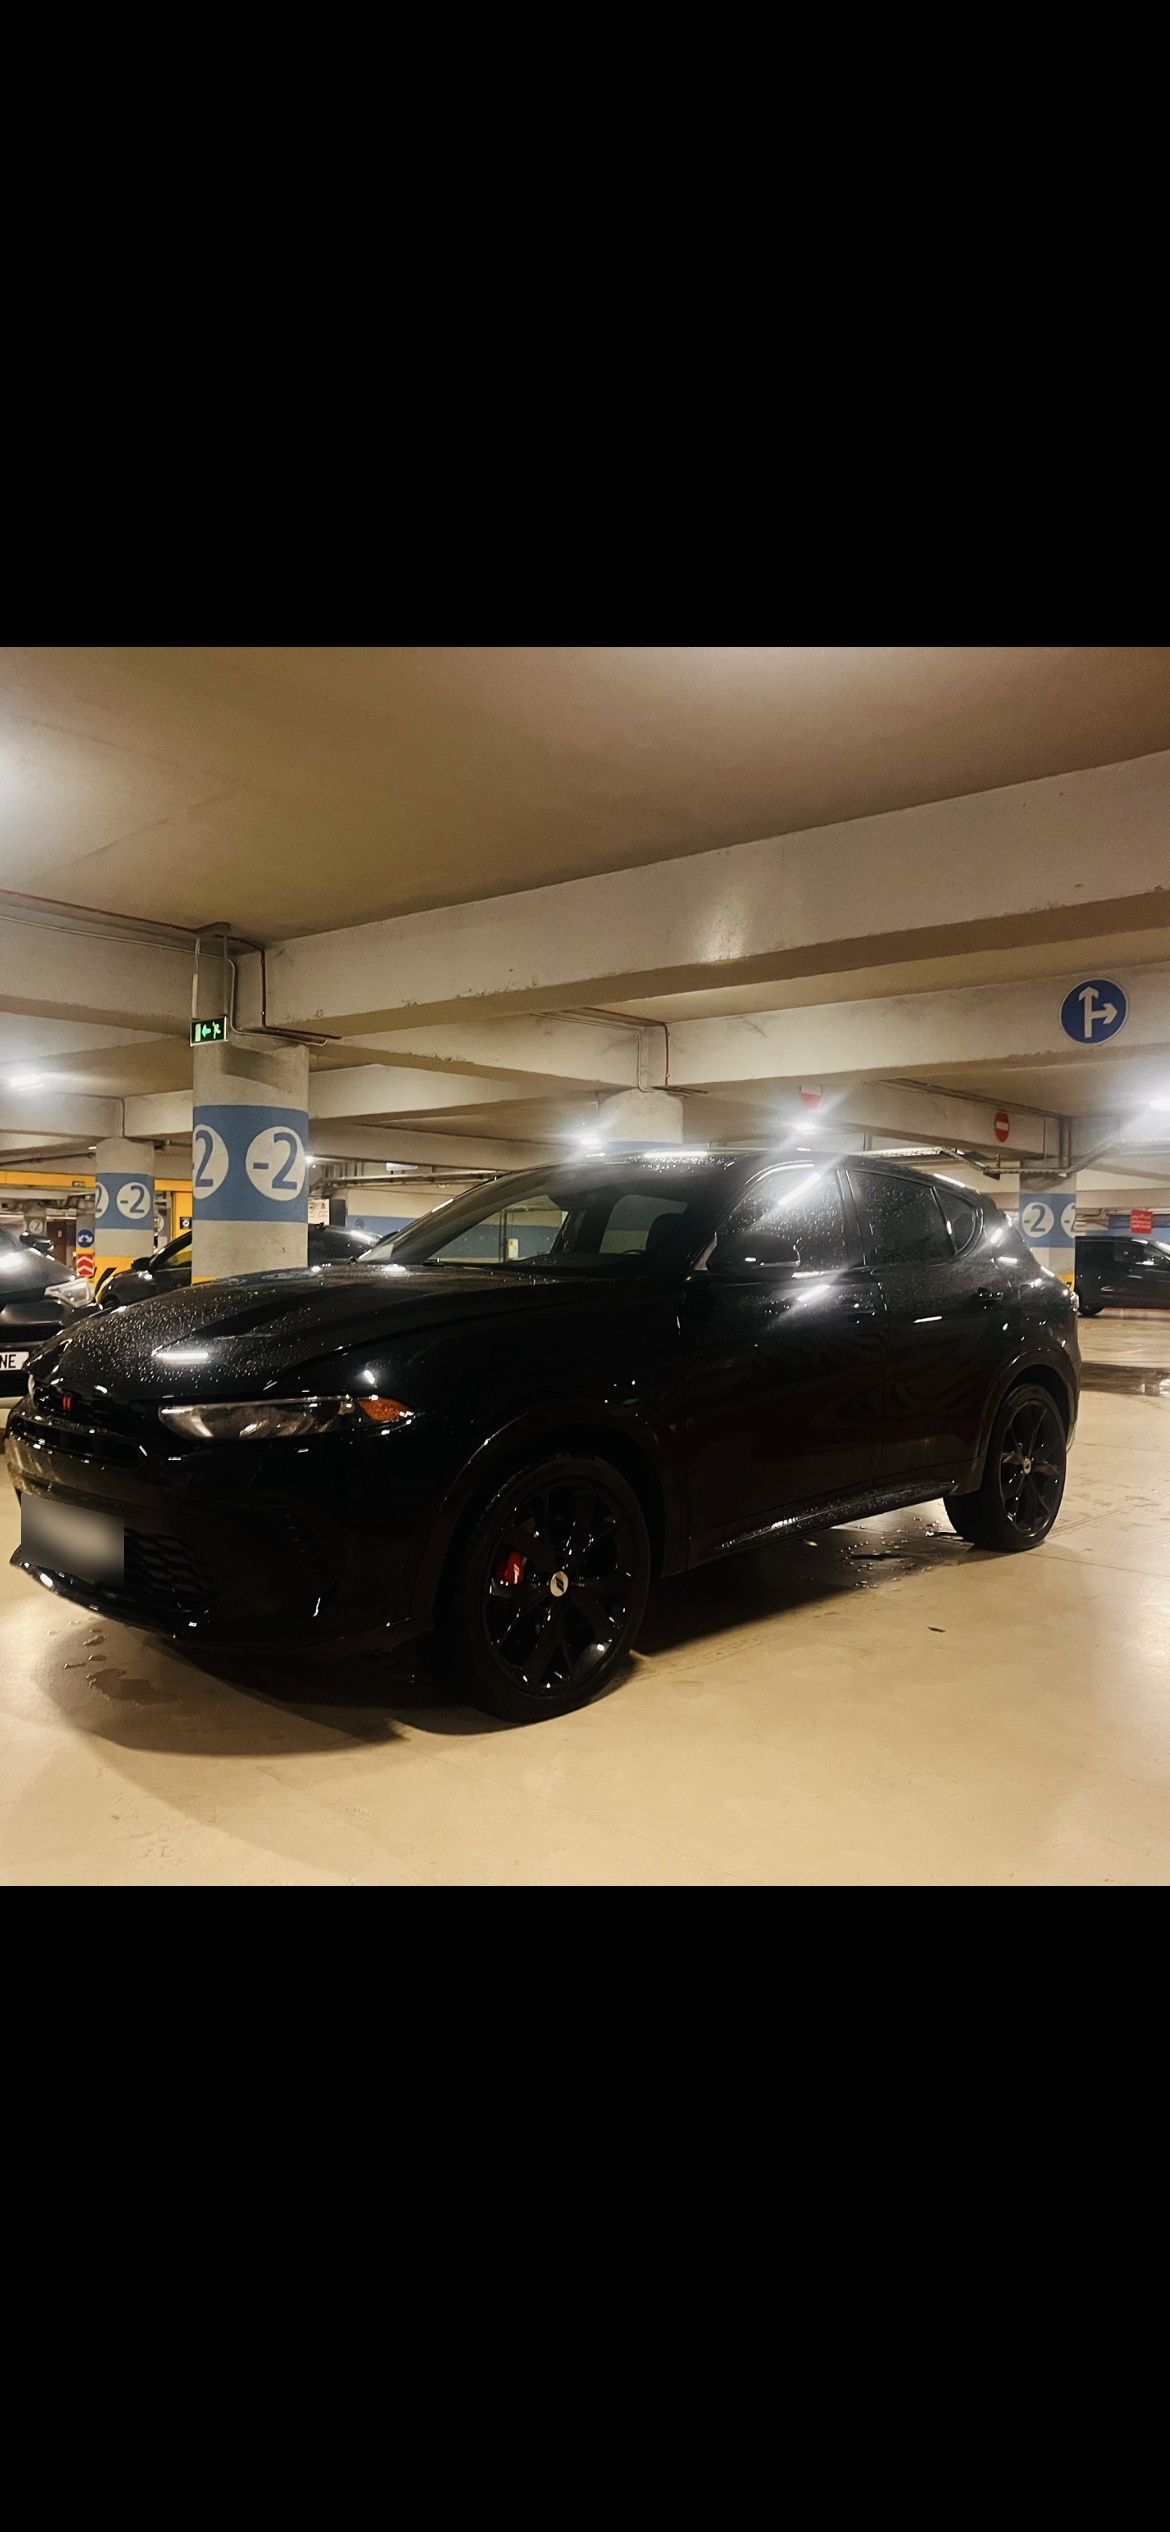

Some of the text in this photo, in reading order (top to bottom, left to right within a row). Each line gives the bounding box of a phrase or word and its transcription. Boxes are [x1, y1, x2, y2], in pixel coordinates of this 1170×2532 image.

[193, 1130, 213, 1187] 2
[253, 1132, 297, 1190] -2
[120, 1185, 144, 1213] -2
[1024, 1205, 1045, 1232] -2
[0, 1354, 16, 1368] NE
